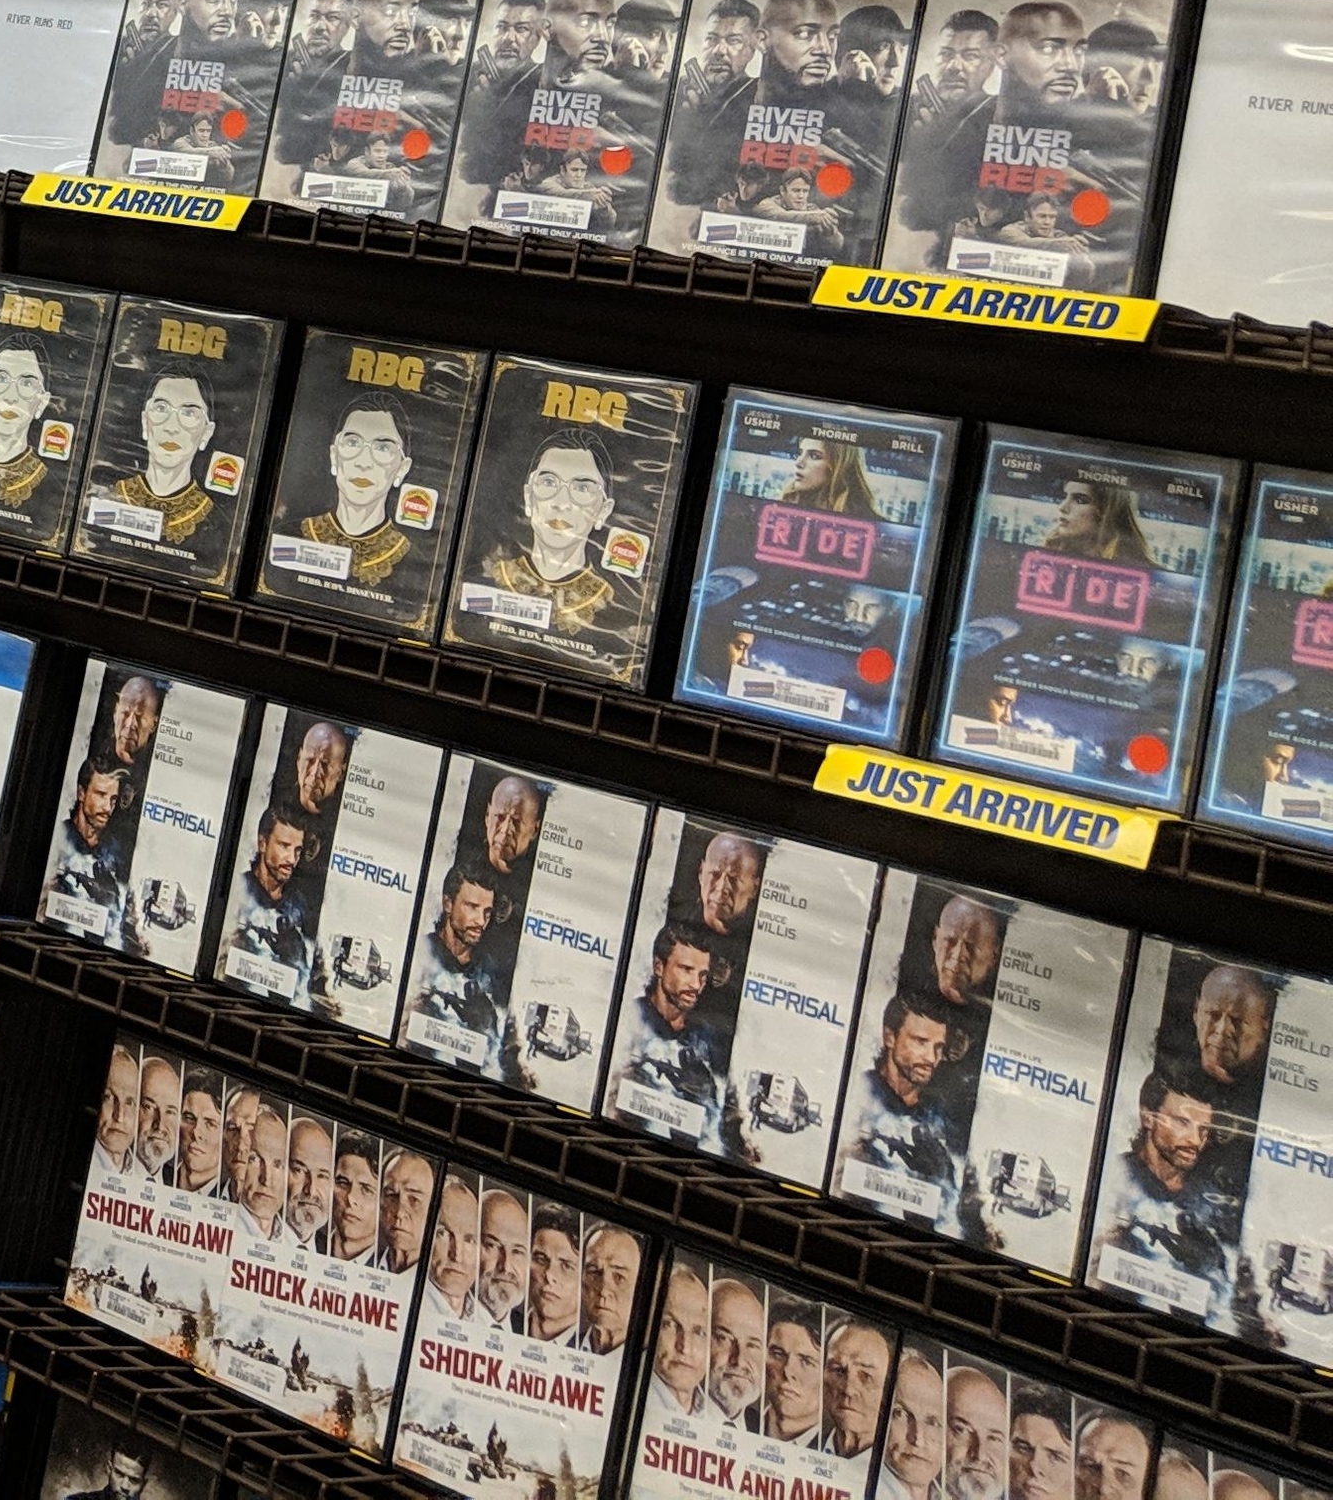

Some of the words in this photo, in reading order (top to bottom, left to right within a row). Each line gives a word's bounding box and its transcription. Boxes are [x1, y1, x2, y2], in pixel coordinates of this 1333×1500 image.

[6, 13, 32, 26] RIVER
[35, 15, 53, 28] RUNS
[57, 18, 72, 30] RED
[341, 75, 404, 95] RIVER
[337, 91, 401, 112] RUNS
[1248, 95, 1294, 113] RIVER
[334, 108, 397, 133] RED
[749, 105, 825, 128] RIVER
[744, 122, 822, 147] RUNS
[986, 125, 1072, 150] RIVER
[739, 142, 819, 169] RED
[983, 143, 1070, 169] RUNS
[979, 163, 1065, 194] RED
[45, 178, 111, 207] JUST
[109, 188, 225, 222] ARRIVED
[0, 292, 65, 334] RBG
[847, 276, 942, 313] JUST
[942, 288, 1121, 331] ARRIVED
[158, 318, 228, 360] RBG
[346, 346, 425, 393] RBG
[542, 380, 633, 429] RBG
[744, 416, 781, 430] USHER
[812, 426, 858, 443] THORNE
[892, 439, 924, 454] BRILL
[404, 497, 430, 514] FRESH
[771, 516, 860, 560] RIDE
[1034, 564, 1133, 609] RIDE
[848, 762, 942, 809] JUST
[947, 782, 1120, 852] ARRIVED
[331, 852, 412, 894] REPRISAL
[764, 879, 791, 891] FRANK
[762, 888, 807, 910] GRILLO
[757, 919, 797, 940] WILLIS
[759, 910, 788, 925] BRUCE
[524, 916, 614, 961] REPRISAL
[1006, 947, 1033, 960] FRANK
[1002, 956, 1052, 979] GRILLO
[997, 989, 1040, 1012] WILLIS
[999, 980, 1030, 995] BRUCE
[744, 980, 845, 1027] REPRISAL
[984, 1053, 1095, 1106] REPRISAL
[230, 1260, 305, 1307] SHOCK
[309, 1288, 345, 1317] AND
[347, 1291, 399, 1332] AWE
[419, 1341, 502, 1390] SHOCK
[505, 1369, 546, 1402] AND
[549, 1373, 605, 1417] AWE
[644, 1434, 735, 1491] SHOCK
